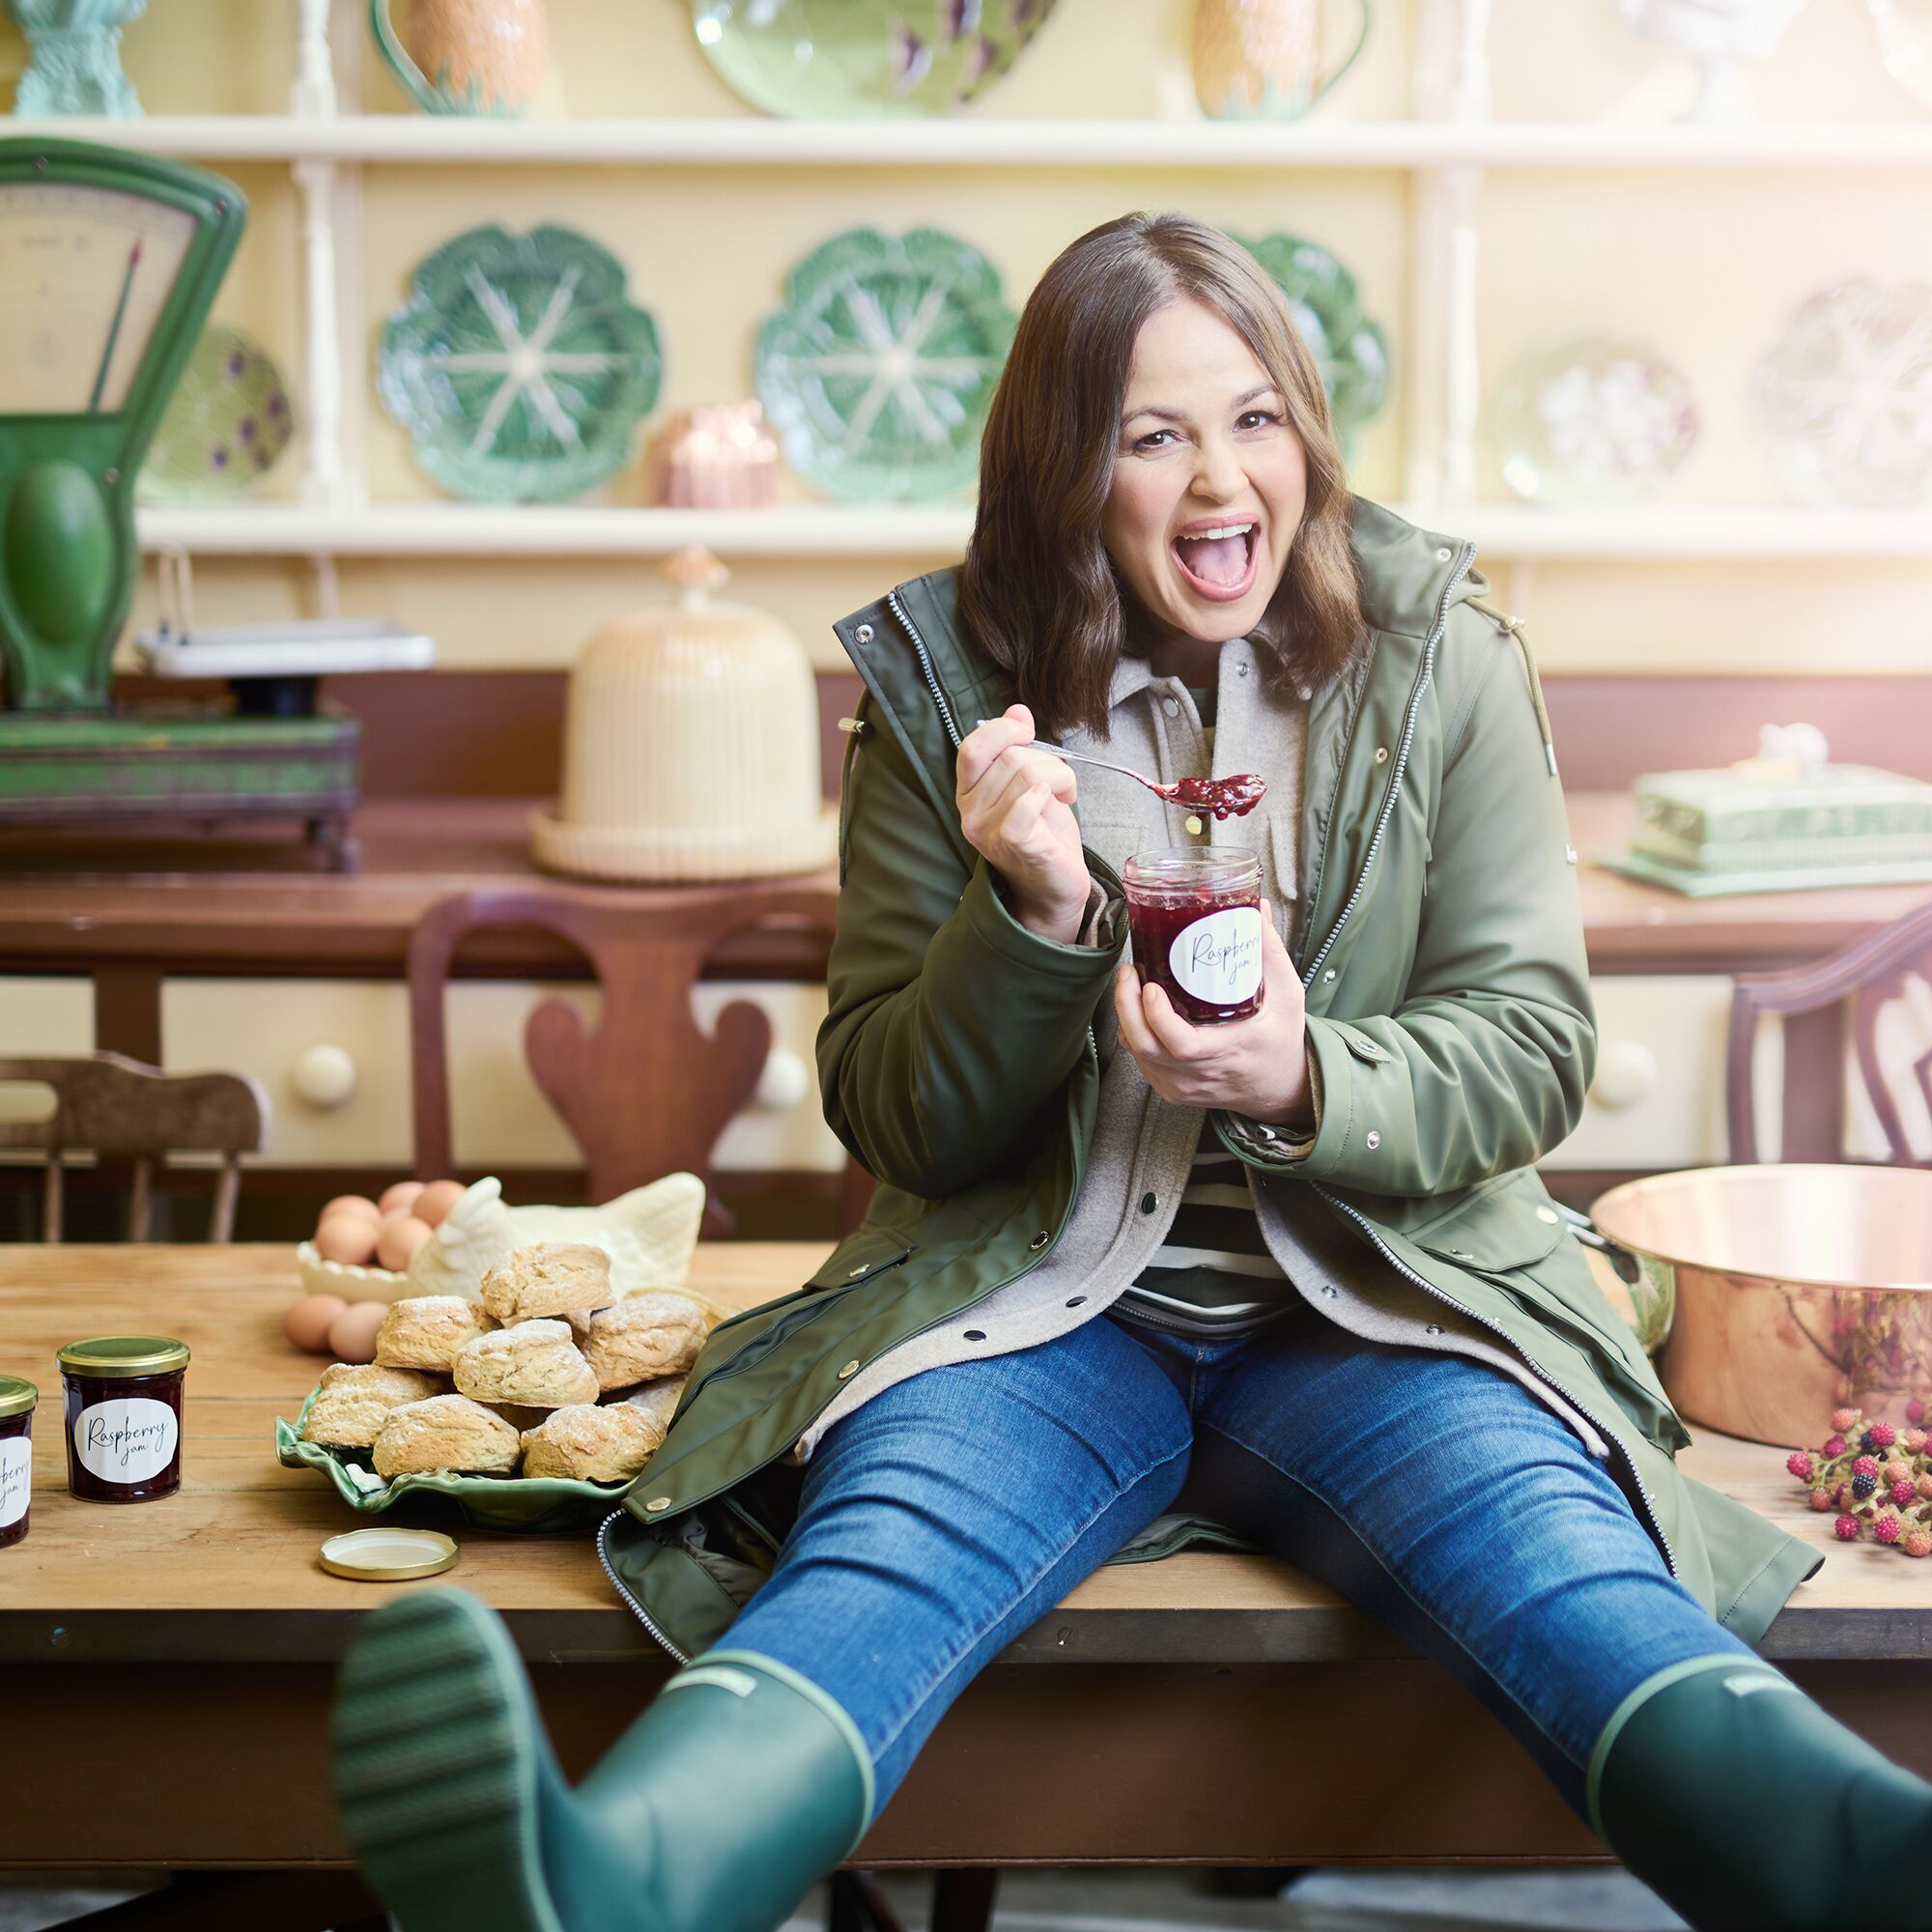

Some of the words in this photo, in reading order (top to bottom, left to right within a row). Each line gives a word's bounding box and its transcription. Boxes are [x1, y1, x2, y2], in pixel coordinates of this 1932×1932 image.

[1229, 959, 1252, 985] jam
[87, 1415, 170, 1455] Raspberry
[120, 1445, 149, 1467] jam
